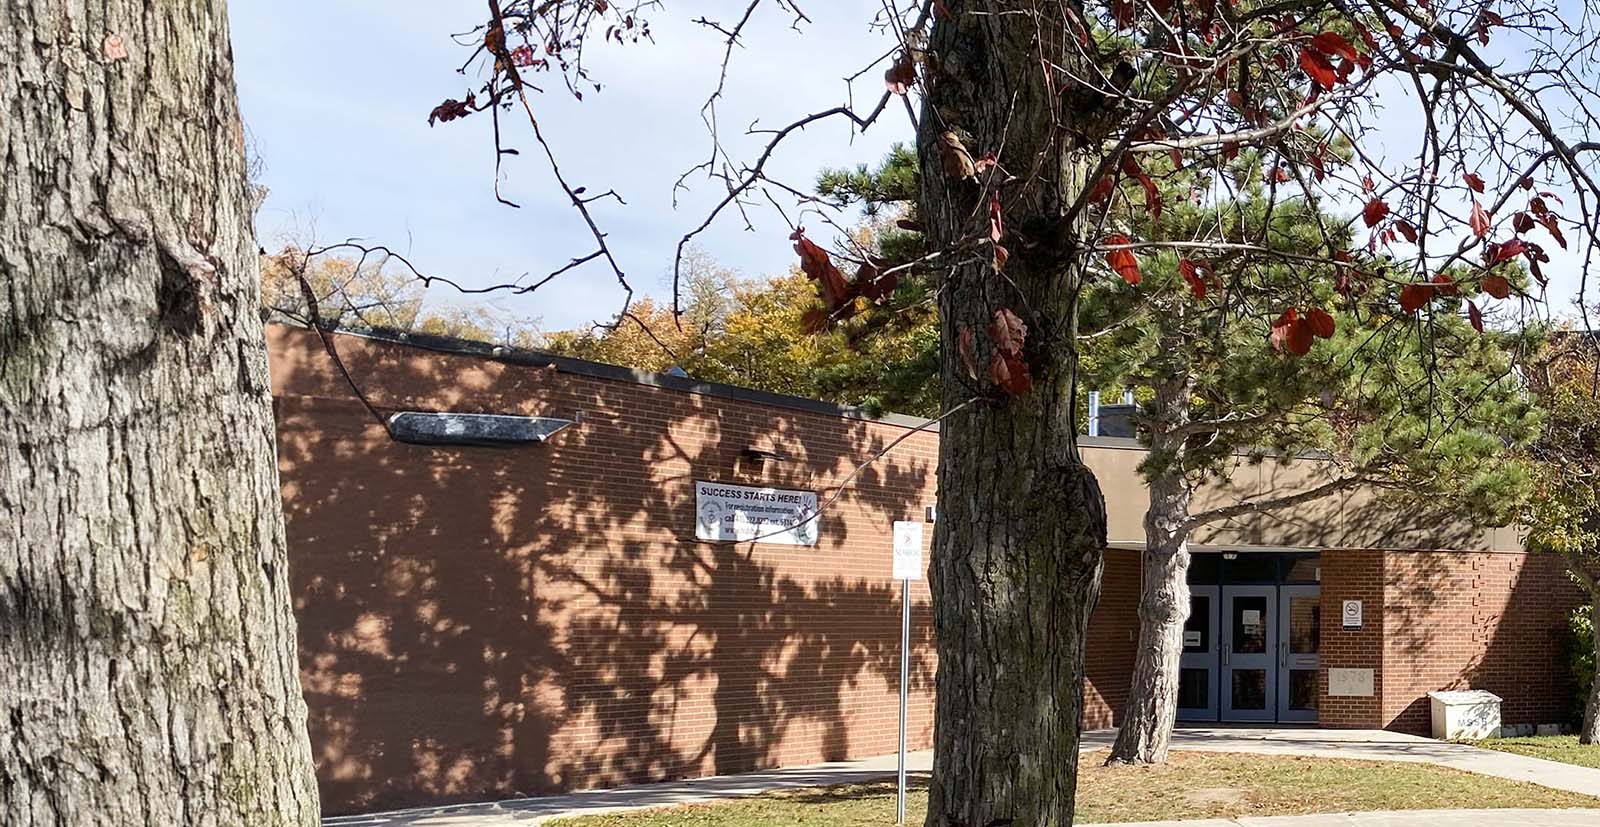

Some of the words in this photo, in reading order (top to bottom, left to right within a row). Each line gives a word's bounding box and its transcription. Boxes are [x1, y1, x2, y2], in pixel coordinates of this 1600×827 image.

[700, 486, 742, 499] SUCCESS
[743, 491, 776, 502] STARTS
[777, 494, 802, 504] HERE!
[765, 505, 795, 515] information
